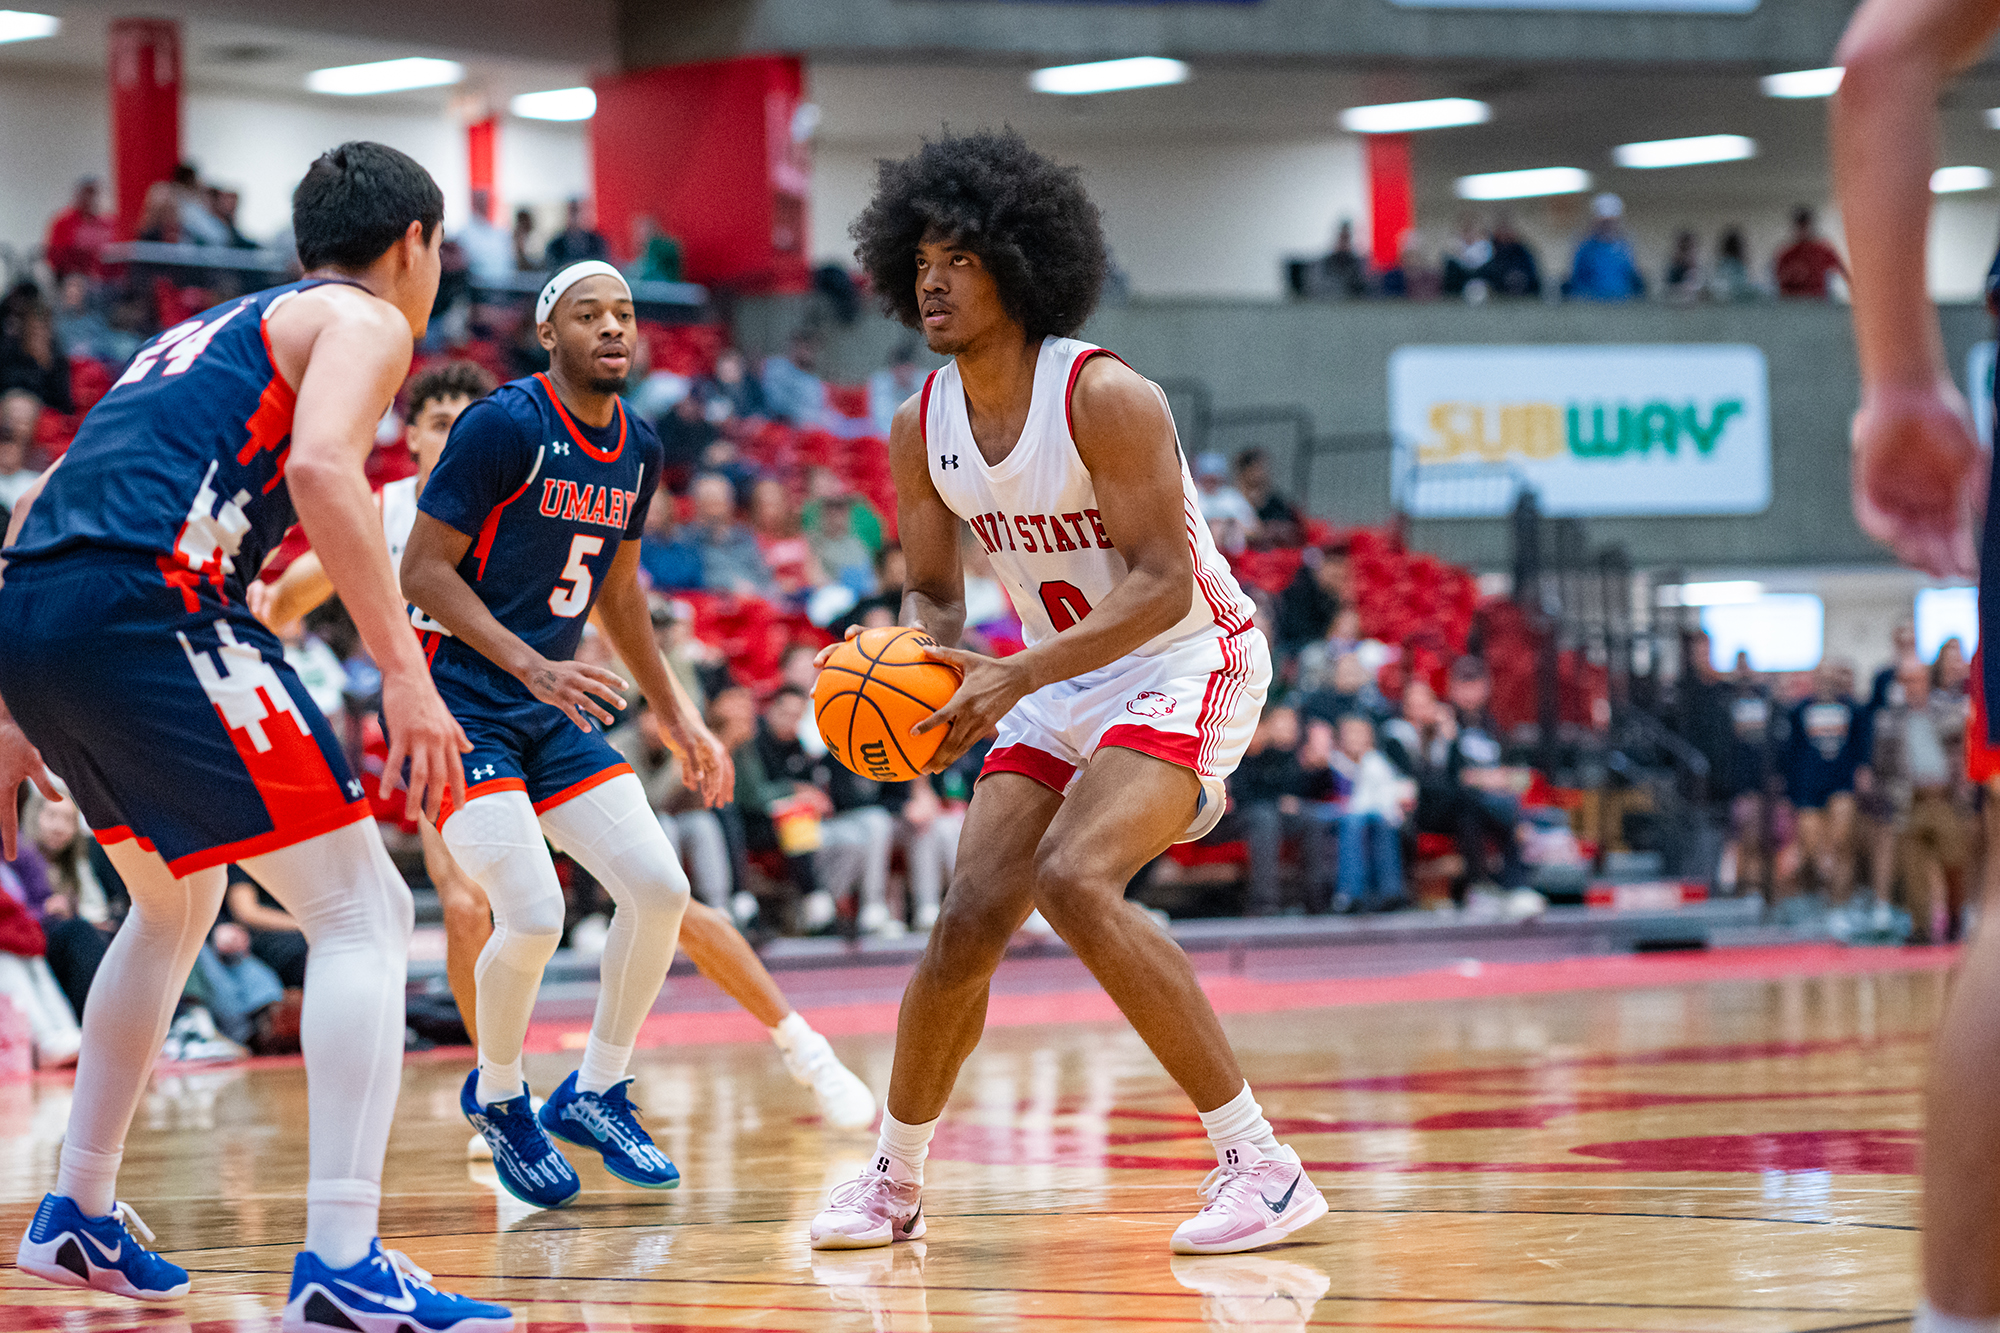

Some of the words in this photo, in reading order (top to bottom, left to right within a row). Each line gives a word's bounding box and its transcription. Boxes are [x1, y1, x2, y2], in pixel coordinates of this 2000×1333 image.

[111, 305, 246, 391] 24
[1417, 399, 1743, 464] SUBWAY
[1013, 508, 1115, 553] STATE
[547, 533, 605, 618] 5
